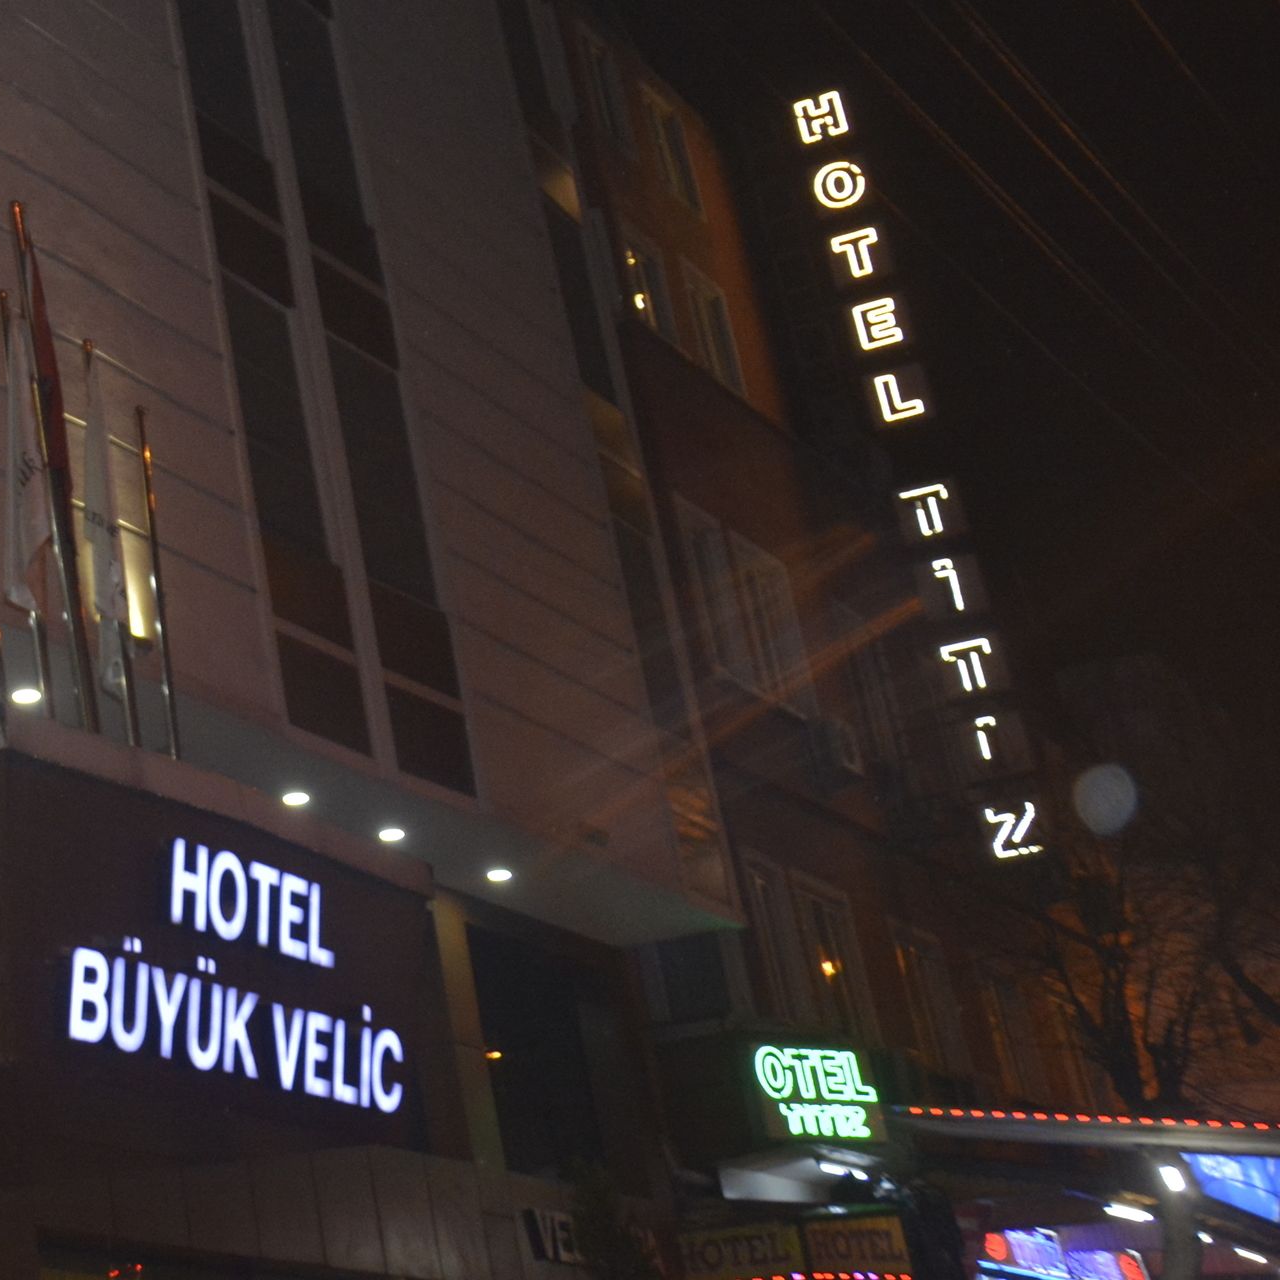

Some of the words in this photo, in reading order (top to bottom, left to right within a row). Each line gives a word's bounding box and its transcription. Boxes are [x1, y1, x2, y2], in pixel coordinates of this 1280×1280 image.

[793, 89, 926, 423] HOTEL
[170, 836, 336, 969] HOTEL
[68, 935, 260, 1080] BÜYÜK
[271, 1003, 405, 1114] VELİC
[753, 1044, 879, 1103] OTEL
